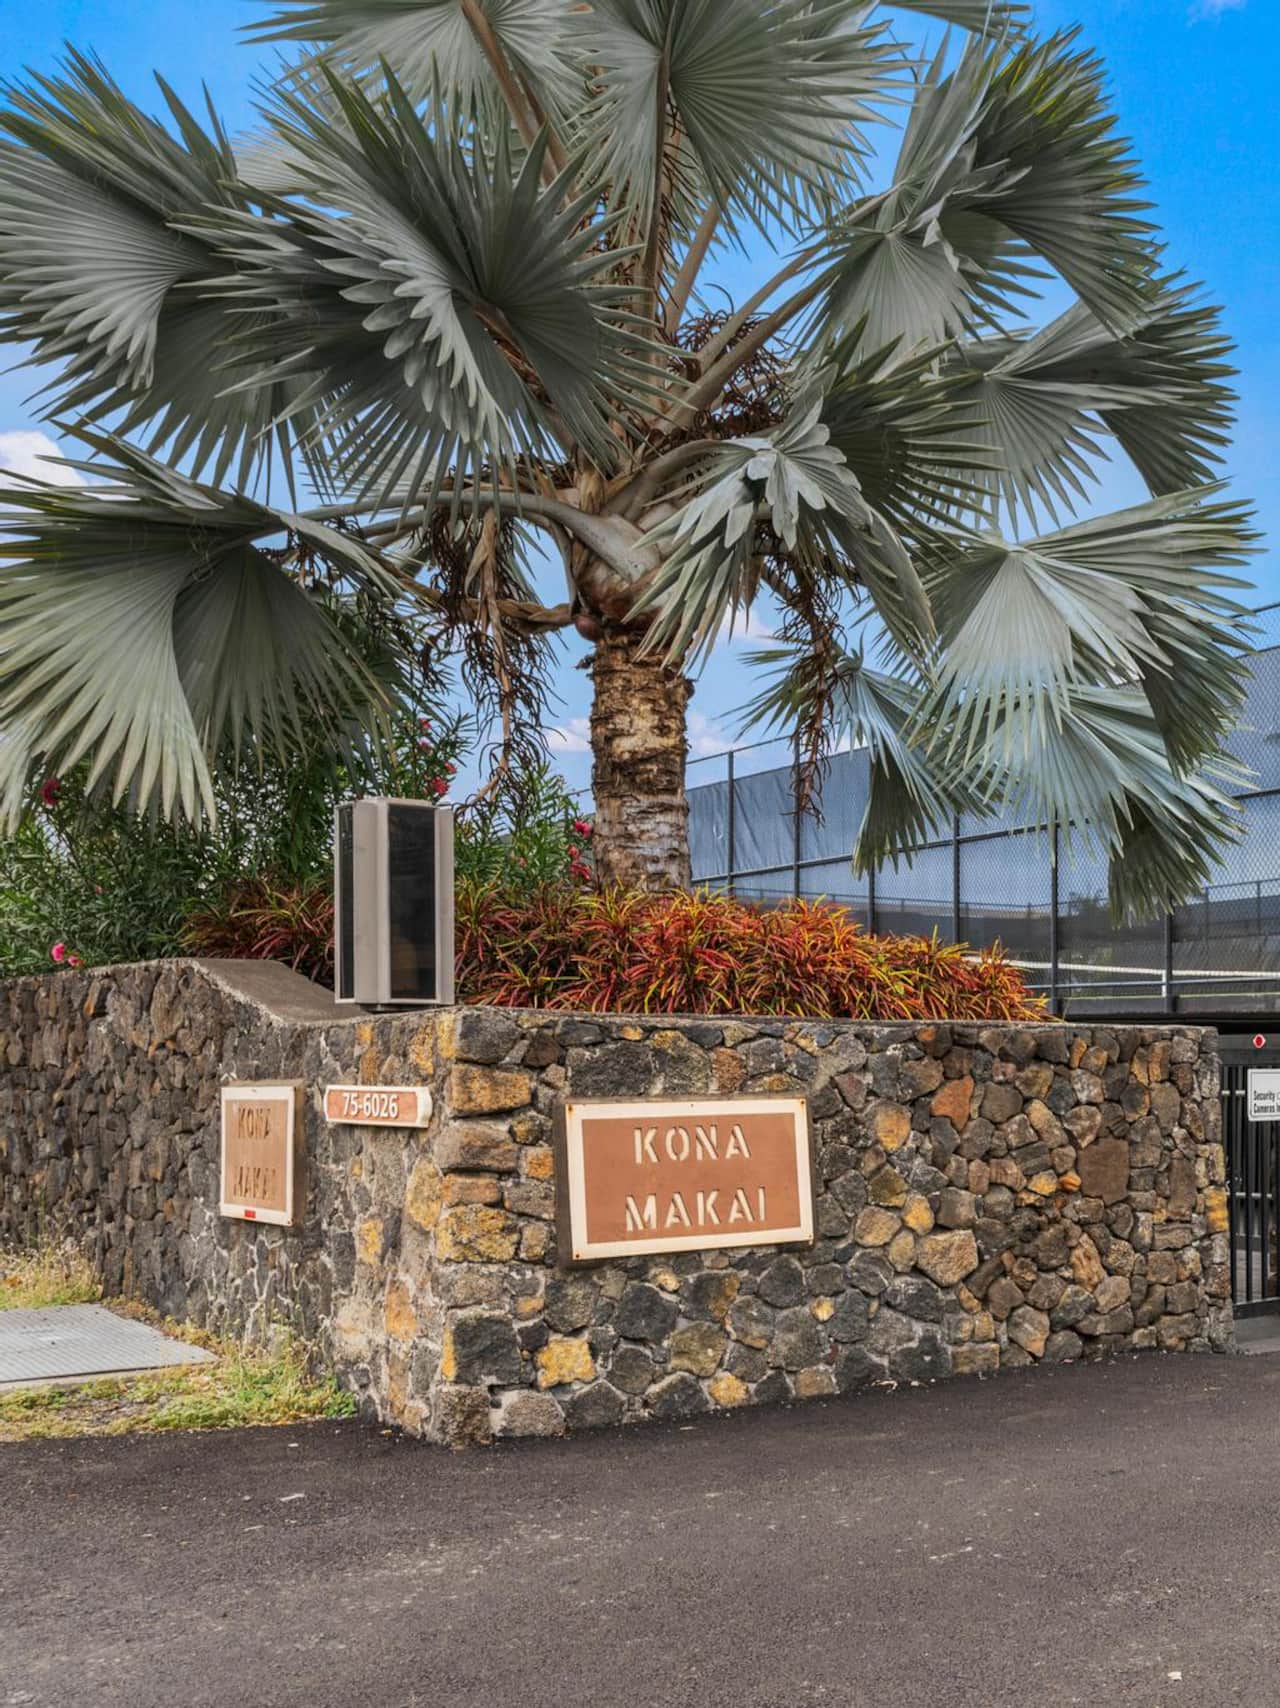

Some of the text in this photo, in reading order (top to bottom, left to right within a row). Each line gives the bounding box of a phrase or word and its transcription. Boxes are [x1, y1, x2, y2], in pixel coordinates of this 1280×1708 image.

[342, 1092, 399, 1119] 75-6026
[1253, 1090, 1276, 1102] Security
[1253, 1102, 1276, 1114] Cameras
[633, 1124, 752, 1165] KONA
[625, 1186, 767, 1232] MAKAI
